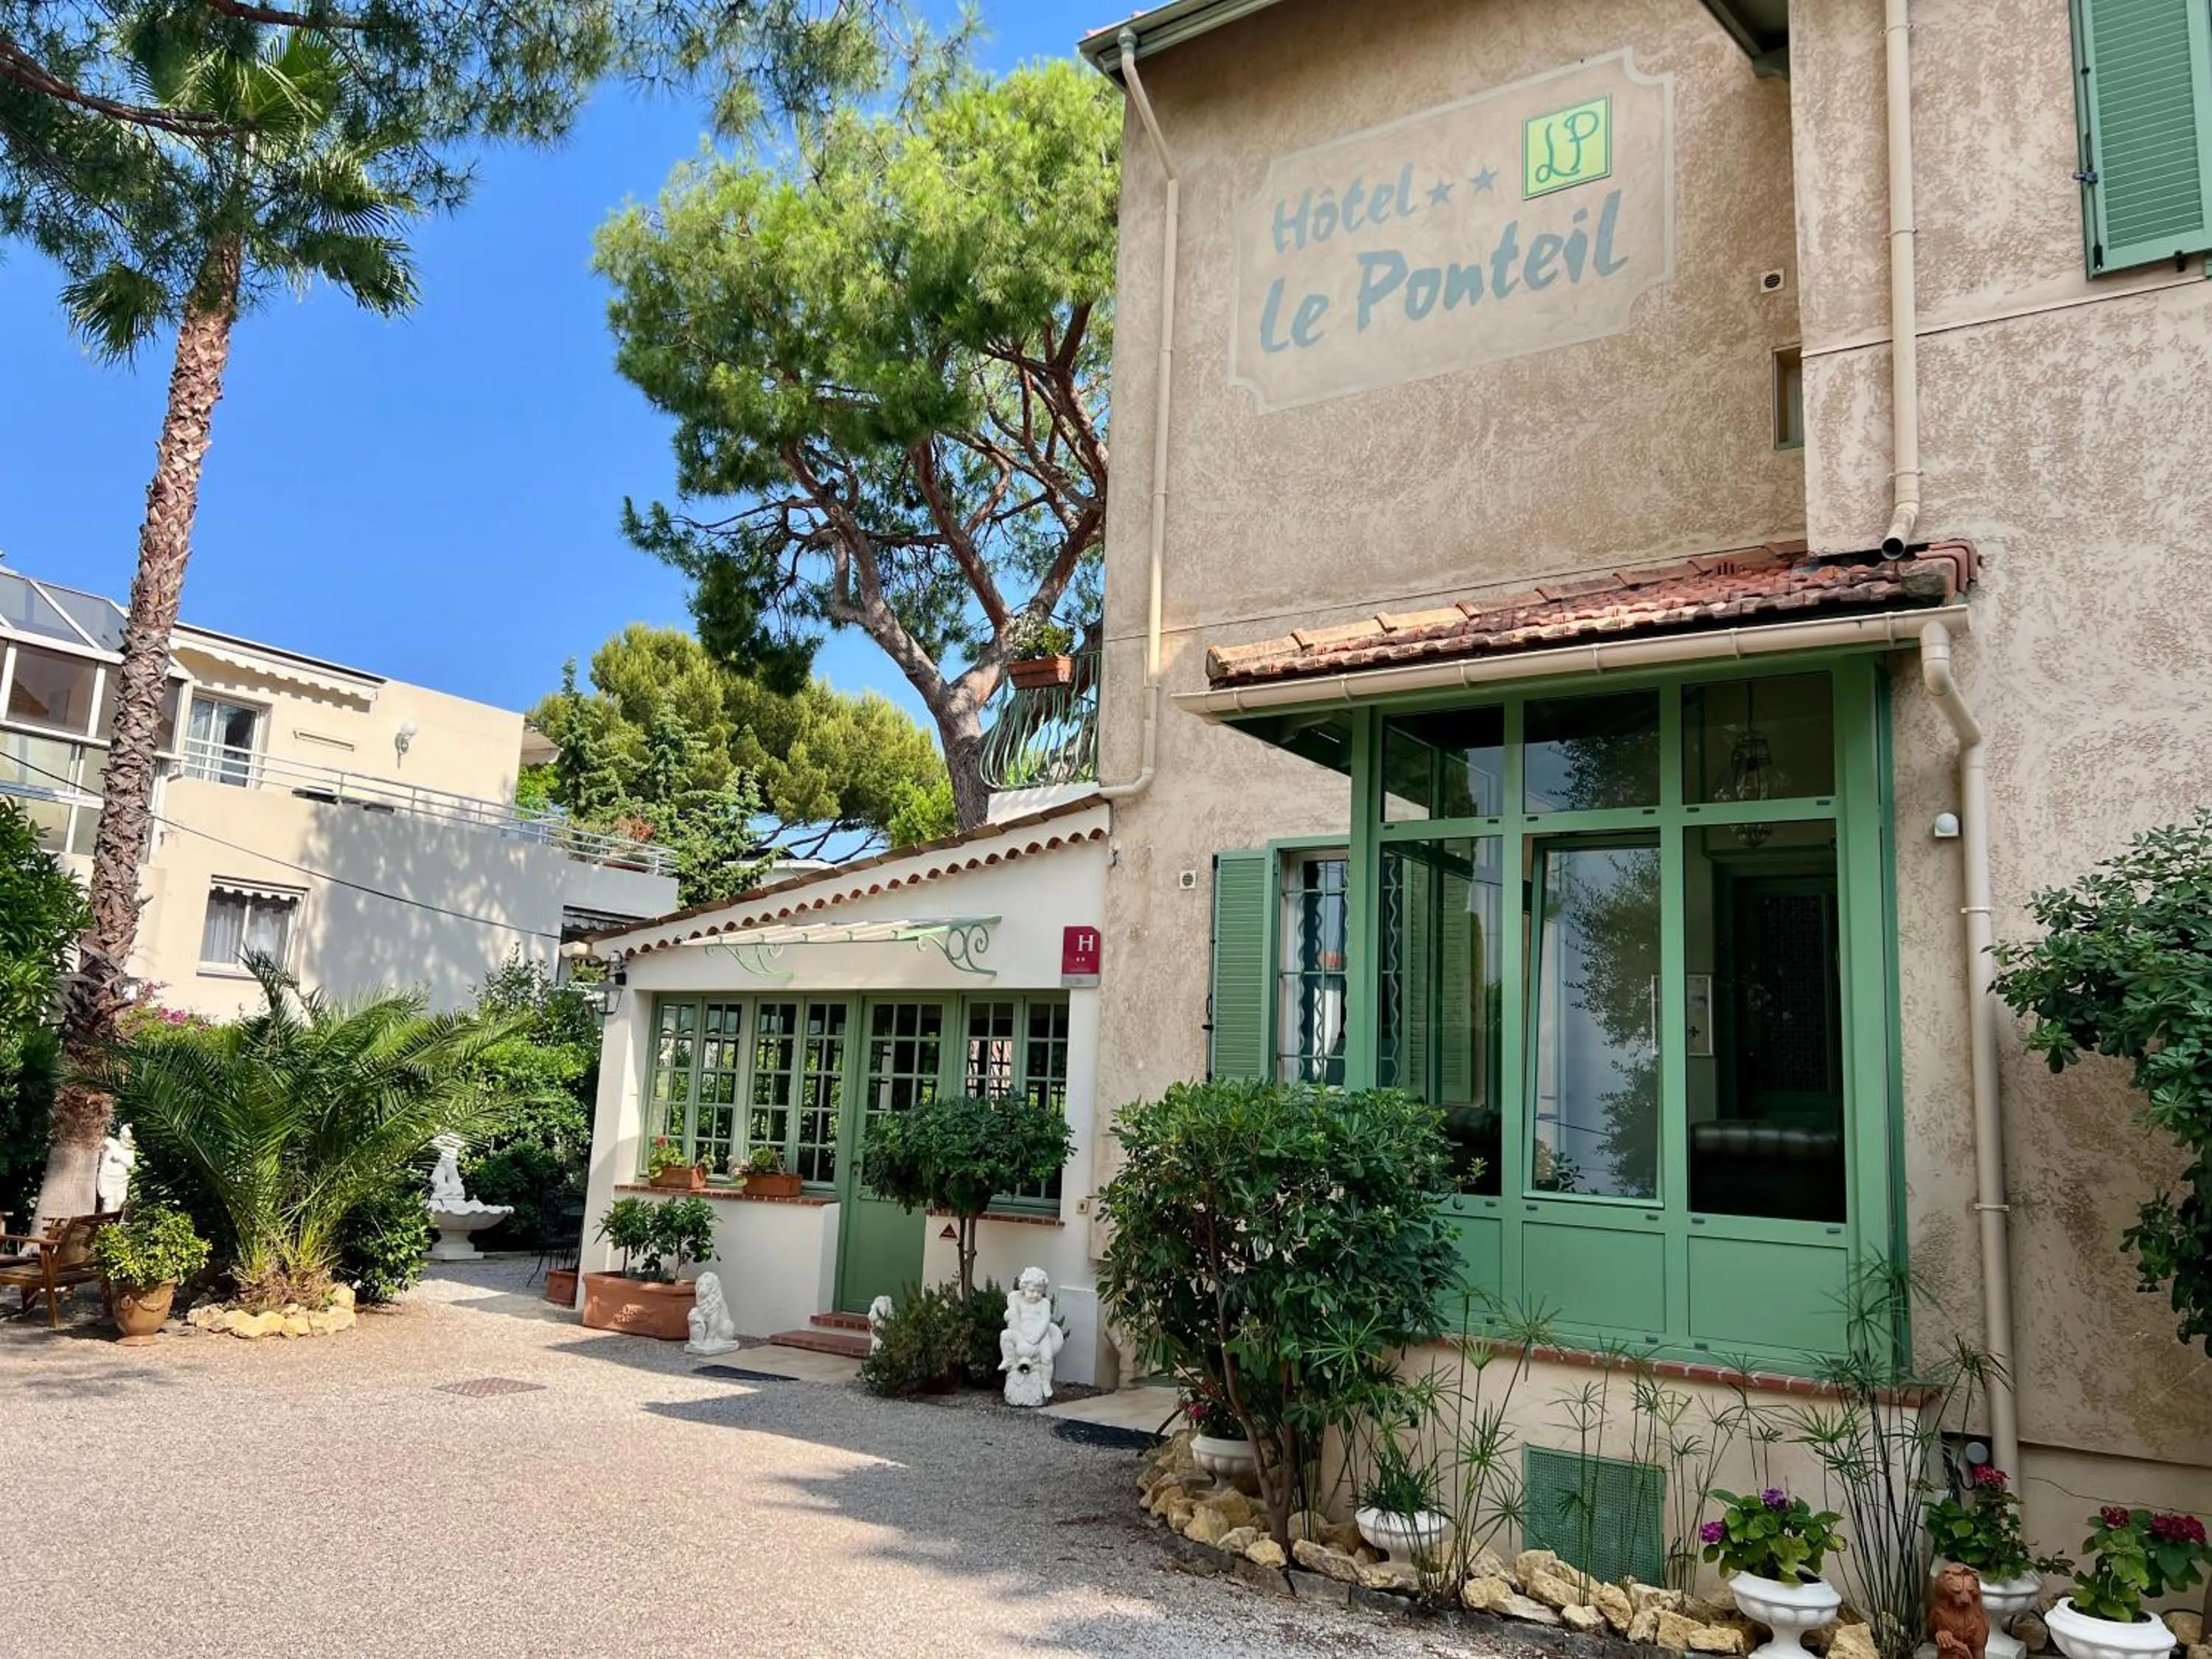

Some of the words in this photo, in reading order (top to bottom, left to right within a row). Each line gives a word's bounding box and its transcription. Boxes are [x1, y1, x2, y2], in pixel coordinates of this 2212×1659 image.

[1272, 163, 1416, 254] Hôtel
[1260, 277, 1329, 353] Le
[1357, 189, 1629, 333] Ponteil
[1077, 934, 1094, 952] H
